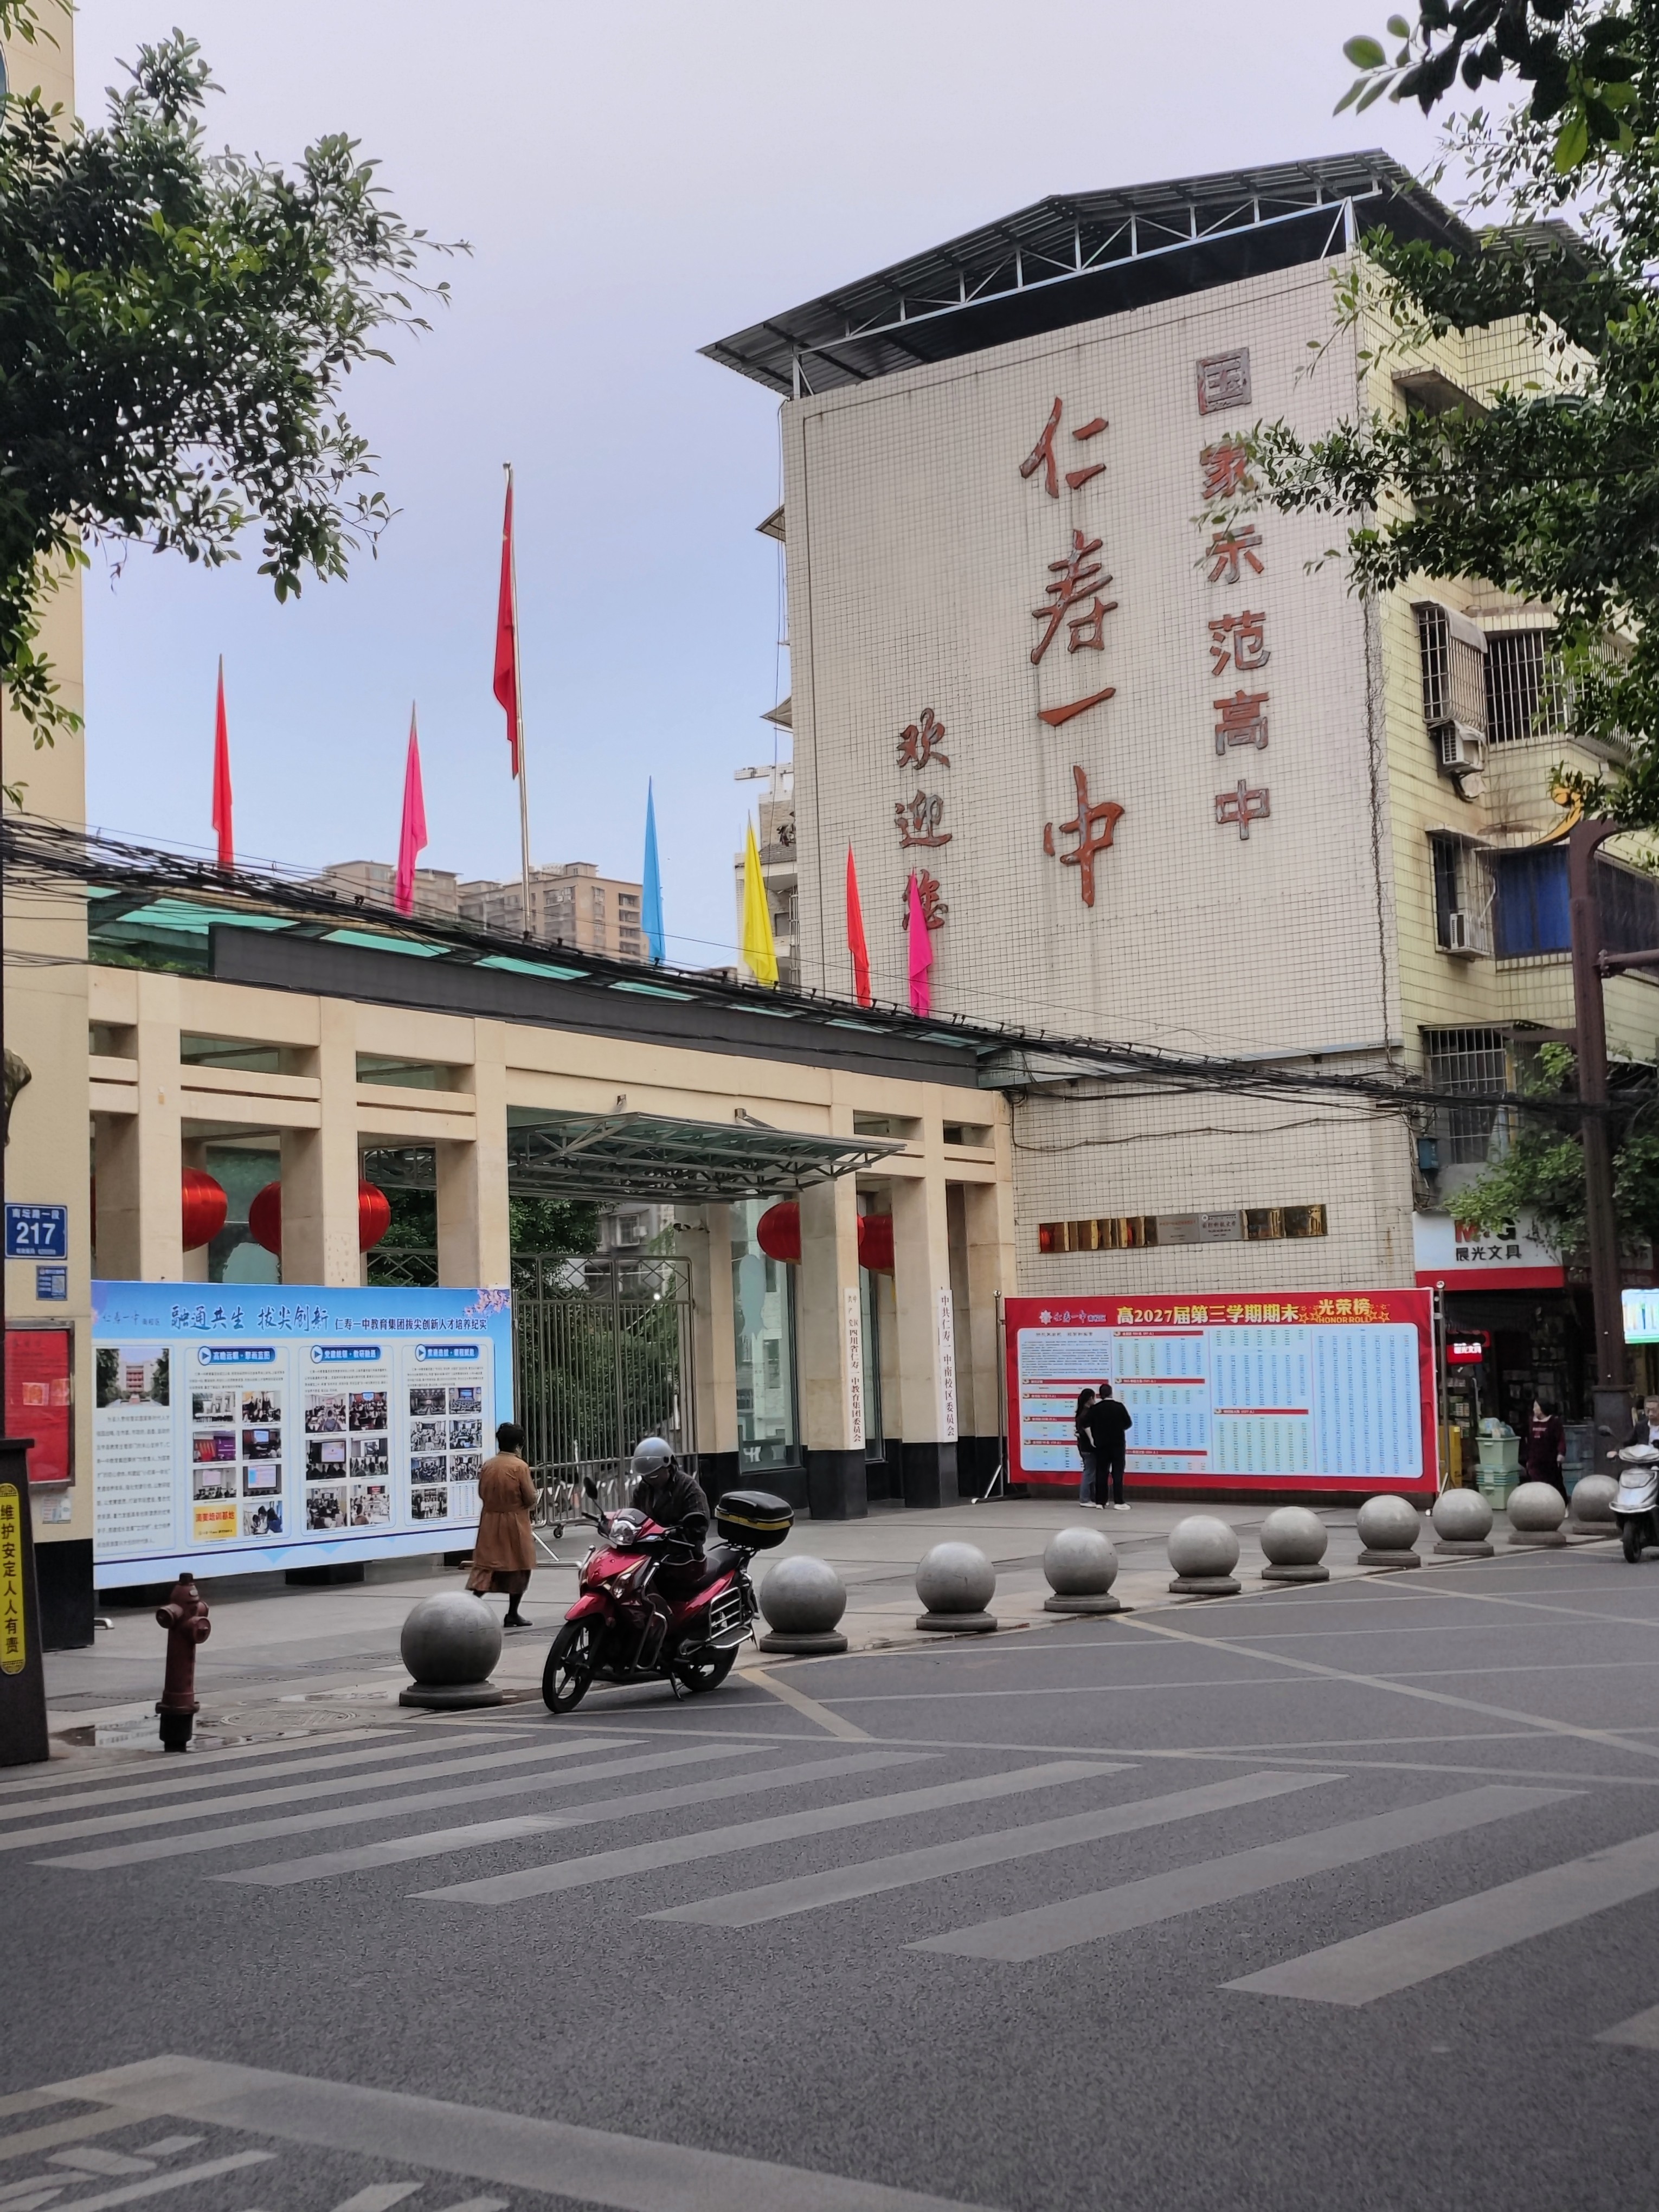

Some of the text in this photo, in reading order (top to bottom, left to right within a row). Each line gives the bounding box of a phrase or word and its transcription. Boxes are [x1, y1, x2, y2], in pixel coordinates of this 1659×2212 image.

[1194, 346, 1271, 841] 国家示范高中
[1020, 396, 1125, 908] 仁寿一中
[16, 1221, 56, 1245] 217
[1456, 1245, 1522, 1262] 晨光文具
[171, 1304, 330, 1332] 融通共生 拔尖创新
[1116, 1303, 1300, 1325] 高2027届第三学期期末
[1318, 1297, 1371, 1316] 光荣榜
[335, 1317, 487, 1331] 仁寿一中教育集团拔尖创新人才培养纪实
[941, 1295, 955, 1437] 中共仁寿一中南校区委员会
[1, 1504, 19, 1654] 维护安定人人有责
